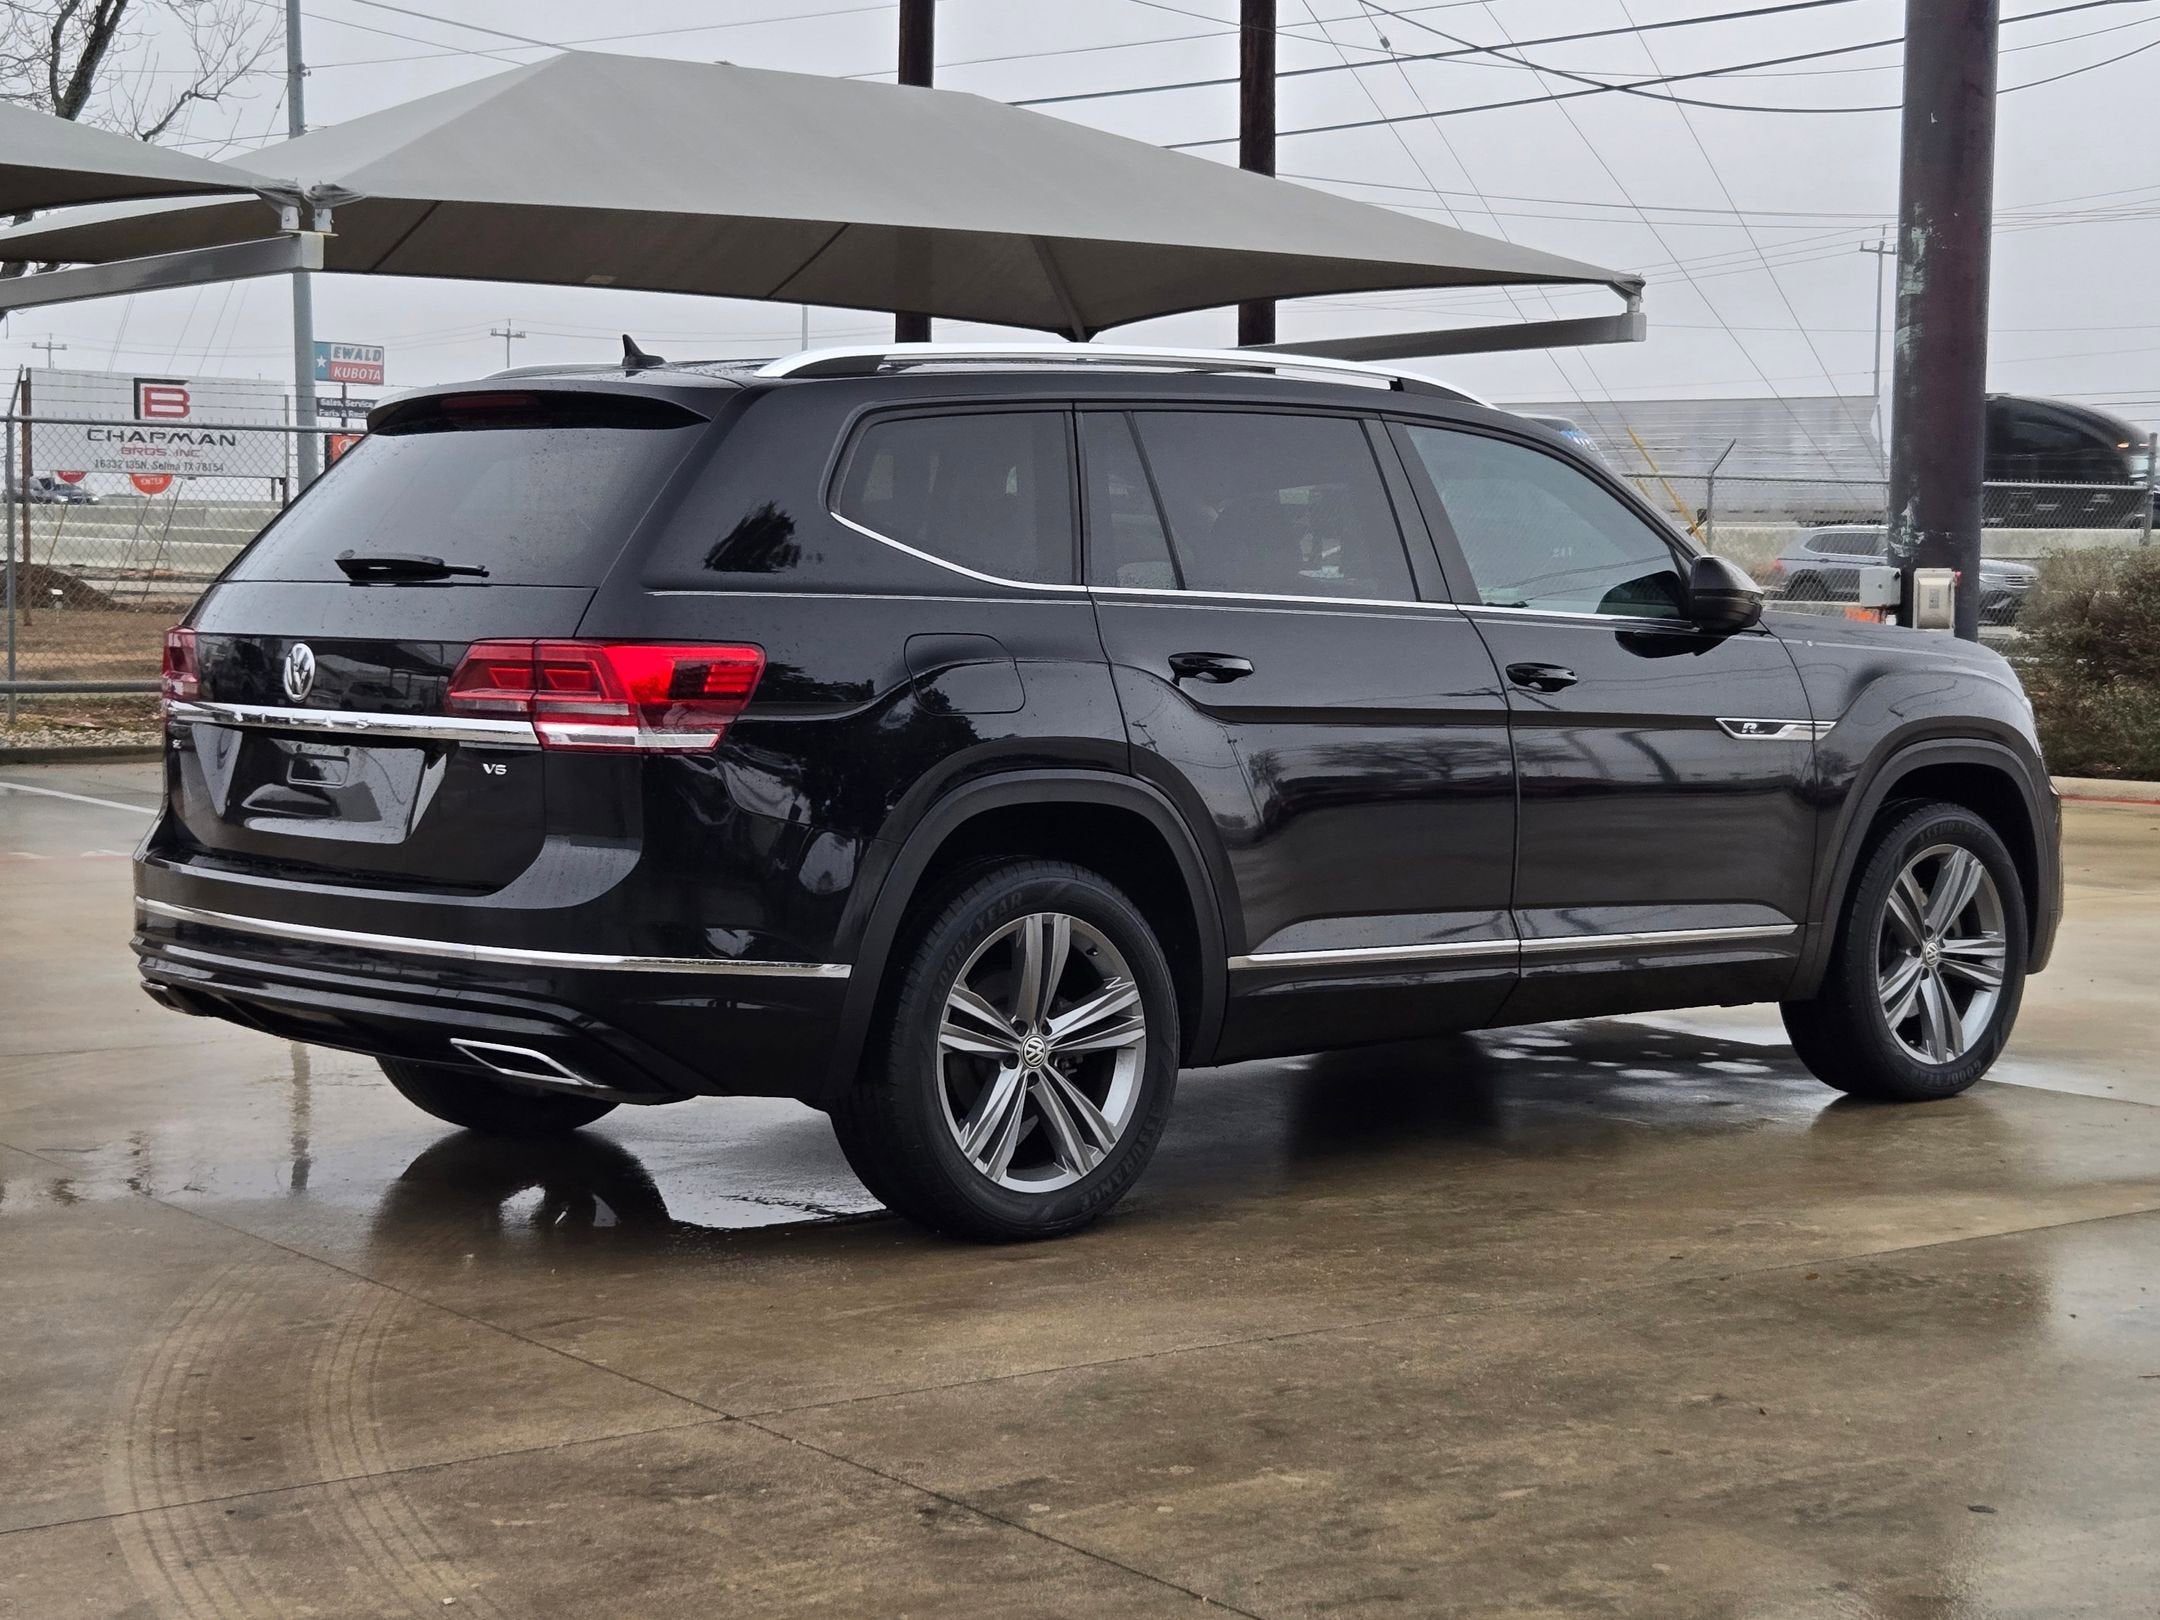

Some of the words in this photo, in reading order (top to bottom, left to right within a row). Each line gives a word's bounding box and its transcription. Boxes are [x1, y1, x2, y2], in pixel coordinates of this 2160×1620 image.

[333, 346, 382, 362] EWALD
[333, 366, 381, 380] KUBOTA
[87, 428, 236, 447] CHAPMAN
[151, 460, 180, 470] Selma
[184, 461, 193, 471] TX
[195, 462, 224, 472] 78154
[482, 763, 507, 775] V6
